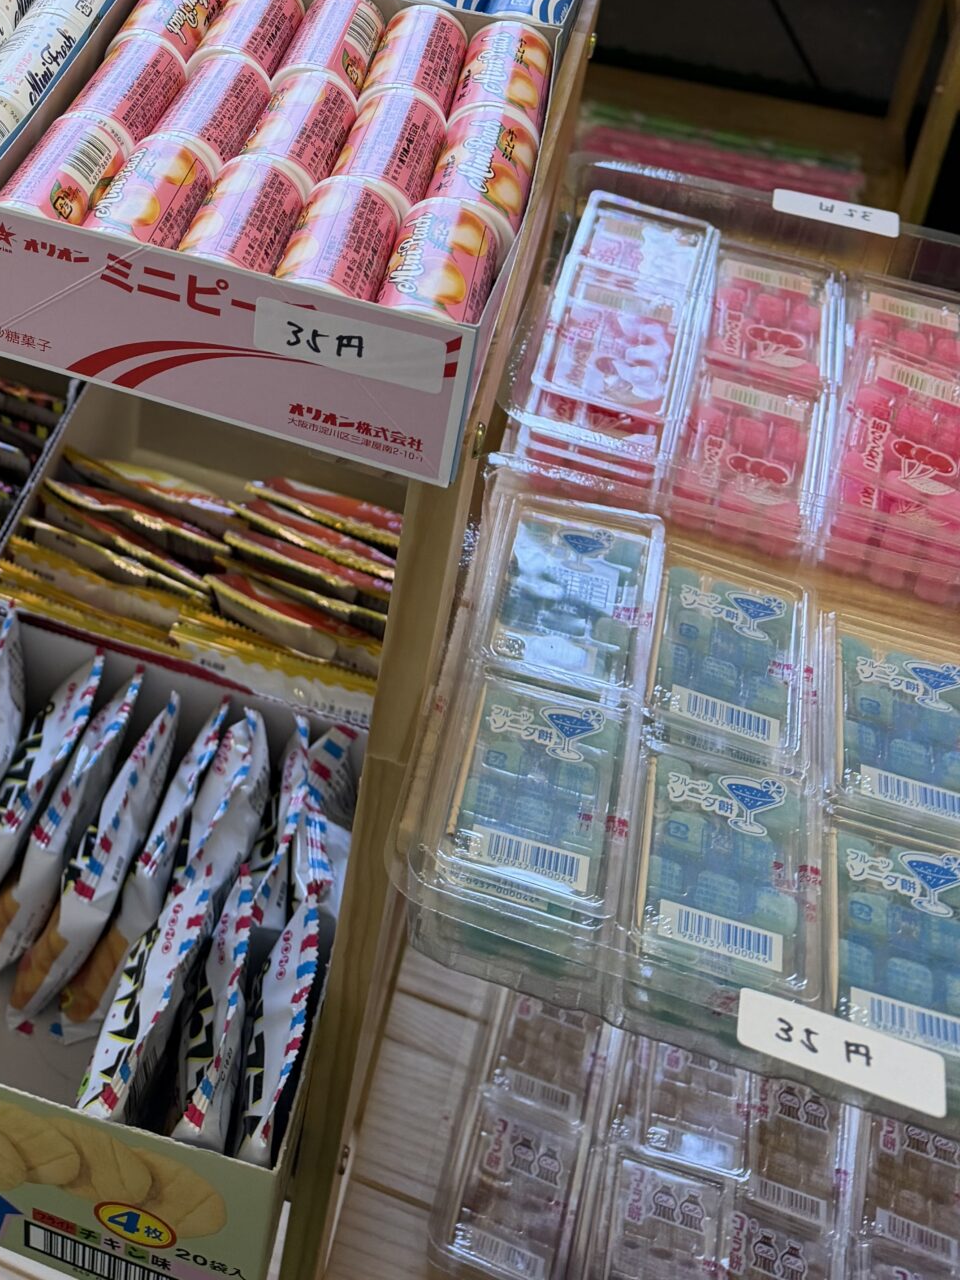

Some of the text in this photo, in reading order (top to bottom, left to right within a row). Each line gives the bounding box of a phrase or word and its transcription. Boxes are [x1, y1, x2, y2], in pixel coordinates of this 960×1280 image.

[39, 27, 78, 68] Fresh
[24, 238, 90, 264] オリオン
[100, 252, 319, 318] ミニピー
[286, 320, 365, 360] 35円
[288, 402, 425, 453] オリオン株式会社
[680, 594, 742, 623] ソーダ餅
[681, 585, 721, 602] フルーツ
[491, 717, 554, 743] ソーダ餅
[493, 706, 533, 722] フルーツ
[668, 773, 712, 791] フルーツ
[667, 783, 736, 817] ソーダ餅
[846, 849, 891, 868] フルーツ
[846, 862, 917, 894] ソーダ餅
[681, 930, 770, 964] 980937 000044
[774, 1017, 874, 1067] 35円
[106, 1210, 165, 1242] 4枚
[174, 1247, 247, 1280] 20袋入
